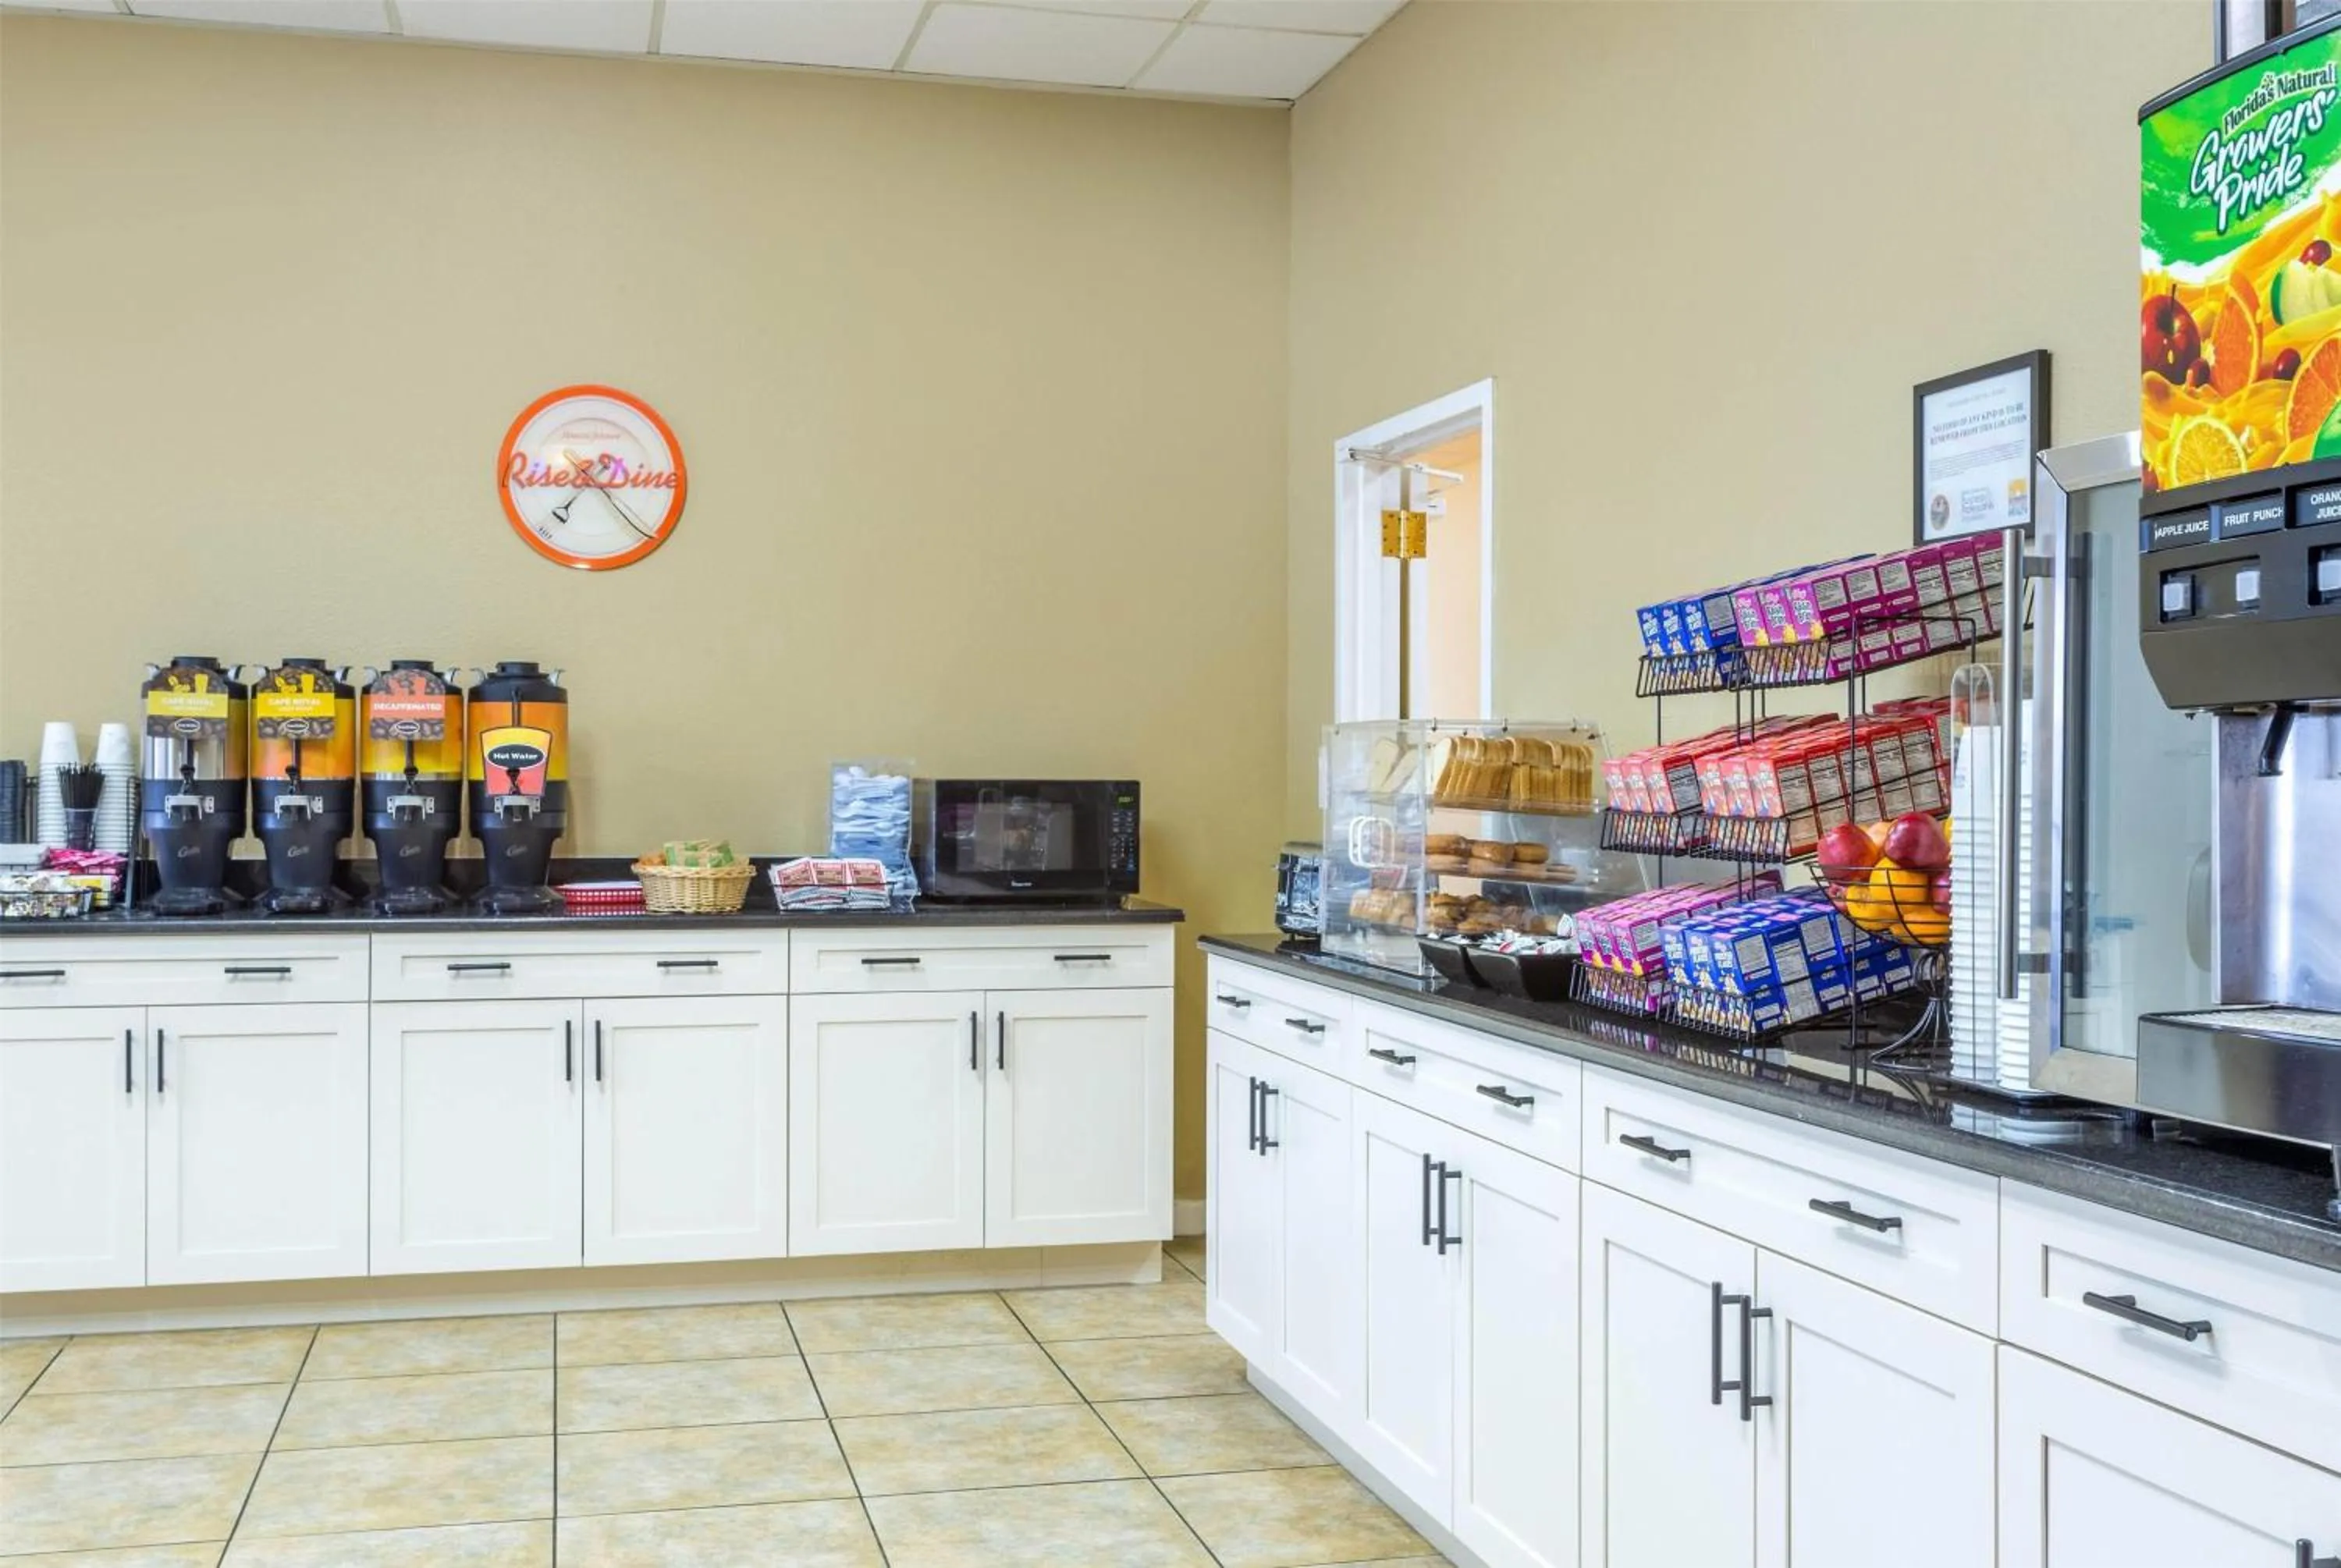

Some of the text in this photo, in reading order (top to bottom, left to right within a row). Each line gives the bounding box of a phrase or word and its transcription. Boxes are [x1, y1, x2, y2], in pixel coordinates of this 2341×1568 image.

[2277, 62, 2334, 98] Natural
[2213, 143, 2304, 232] Pride
[502, 452, 570, 489] Rise
[2311, 490, 2341, 506] ORAN
[2184, 520, 2209, 534] JUICE
[2224, 506, 2284, 527] FRUIT PUNCH
